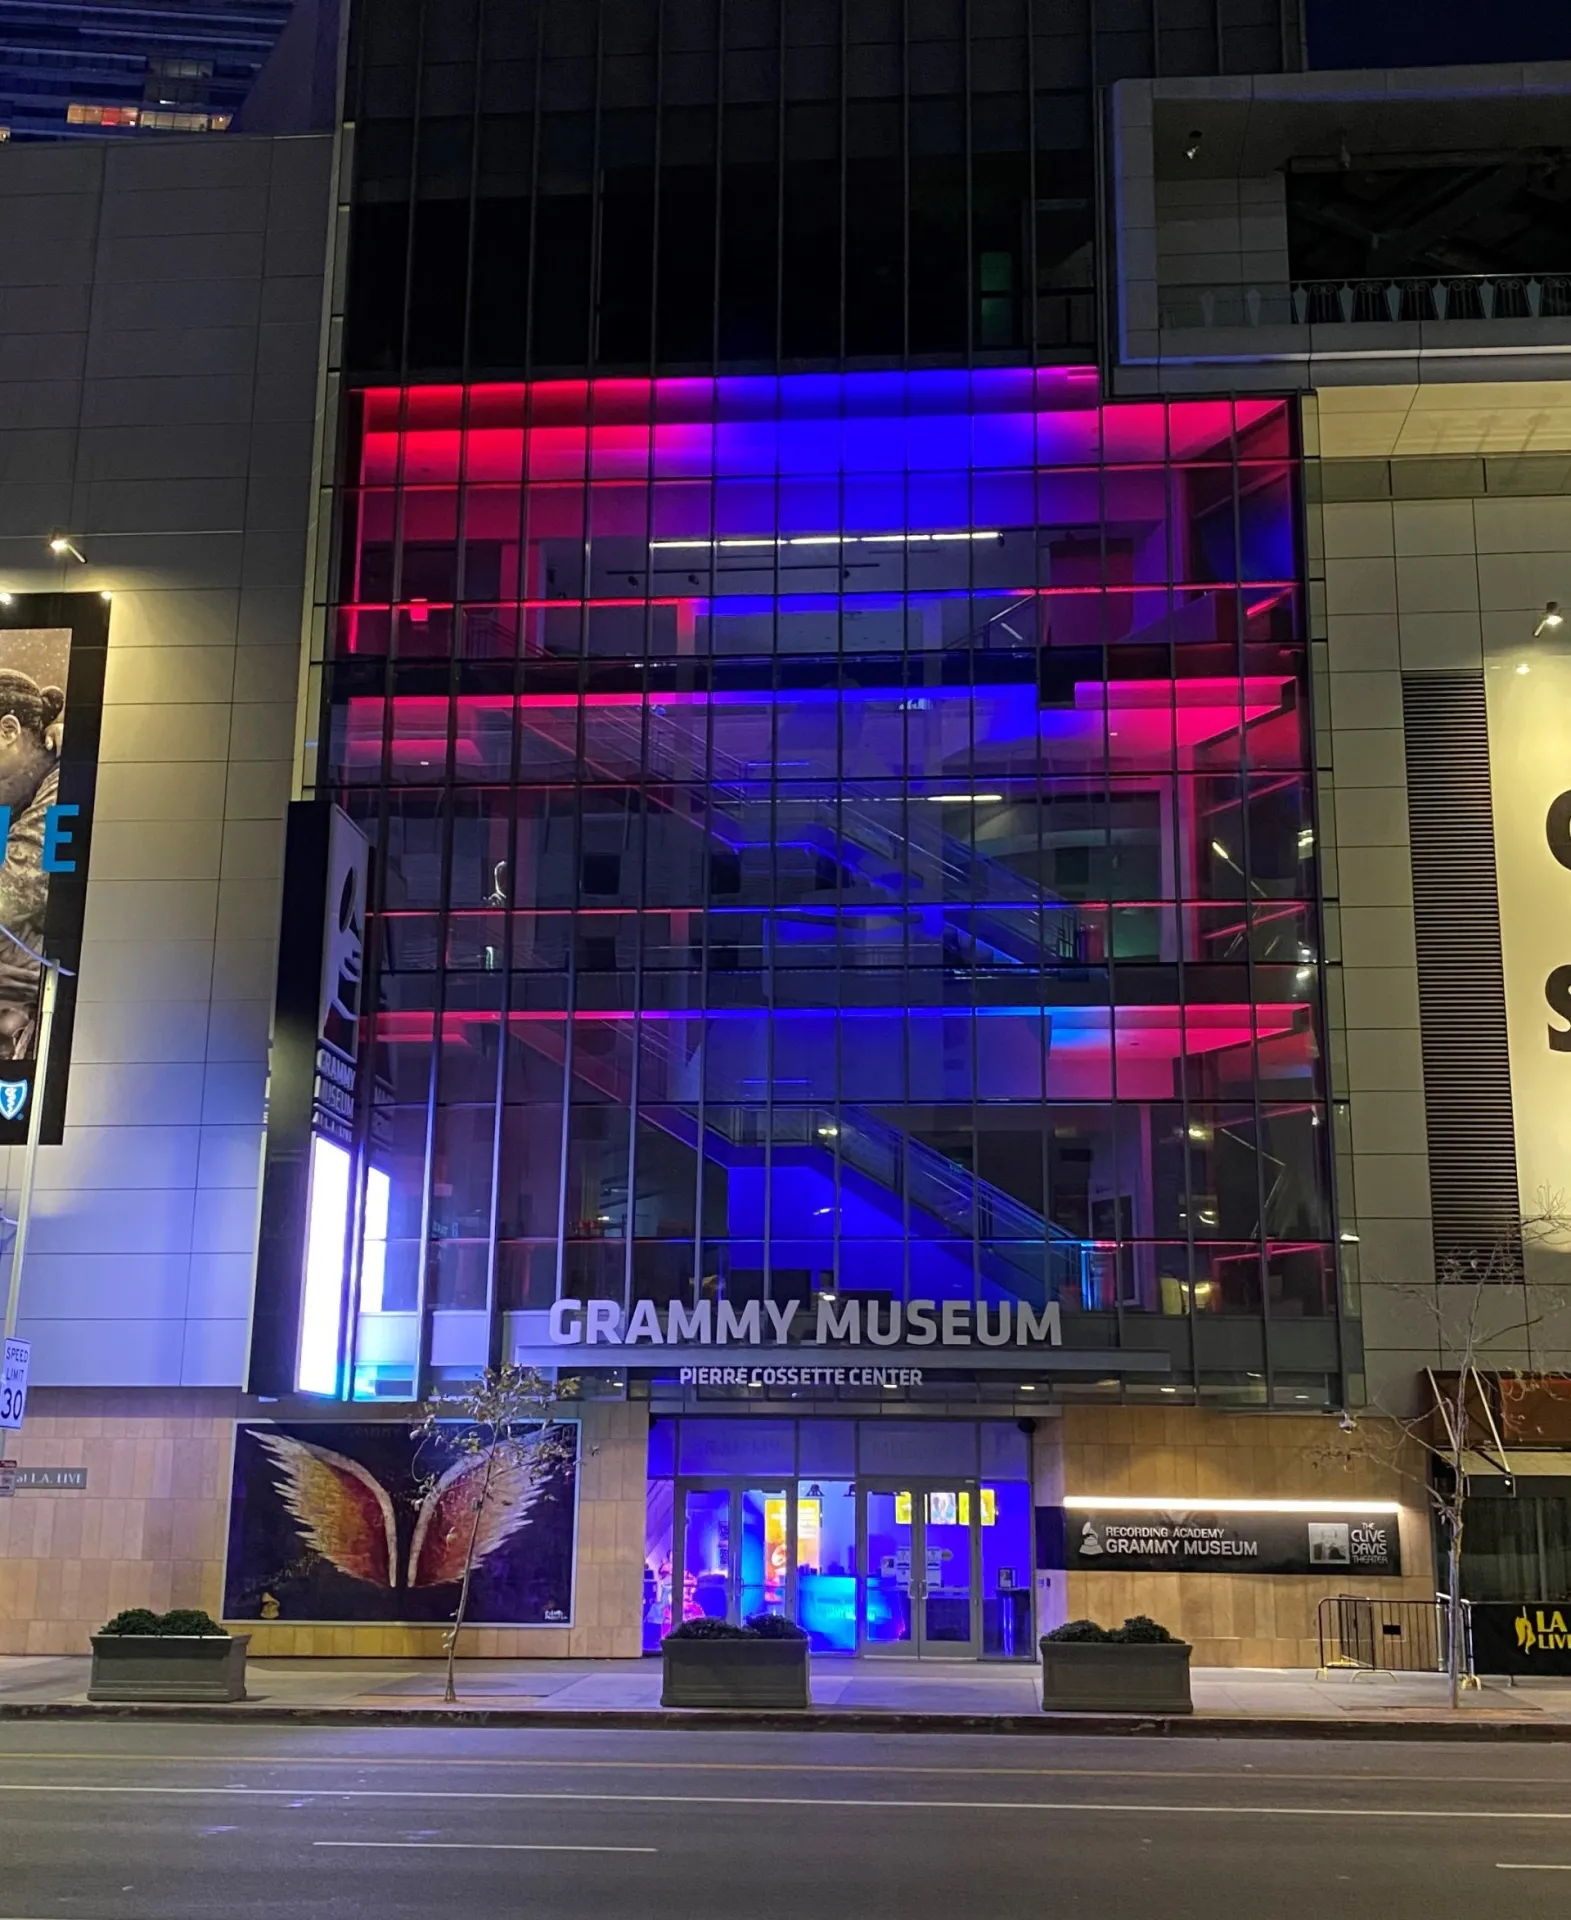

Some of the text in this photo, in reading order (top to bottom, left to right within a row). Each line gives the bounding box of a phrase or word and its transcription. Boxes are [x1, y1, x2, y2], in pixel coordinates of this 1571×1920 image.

[316, 1048, 356, 1091] GRAMMY
[314, 1075, 354, 1119] MUSEUM
[549, 1299, 1062, 1346] GRAMMY MUSEUM
[6, 1347, 29, 1363] SPEED
[6, 1369, 25, 1382] LIMIT
[680, 1367, 922, 1386] PIERRE COSSETTE CENTER
[1, 1388, 23, 1420] 30
[1105, 1527, 1225, 1539] RECORDING ACADEMY
[1361, 1522, 1376, 1530] THE
[1351, 1529, 1387, 1542] CLIVE
[1106, 1539, 1258, 1556] GRAMMY MUSEUM
[1351, 1543, 1387, 1555] DAVIS
[1352, 1555, 1389, 1564] THEATER
[1536, 1610, 1568, 1632] LA
